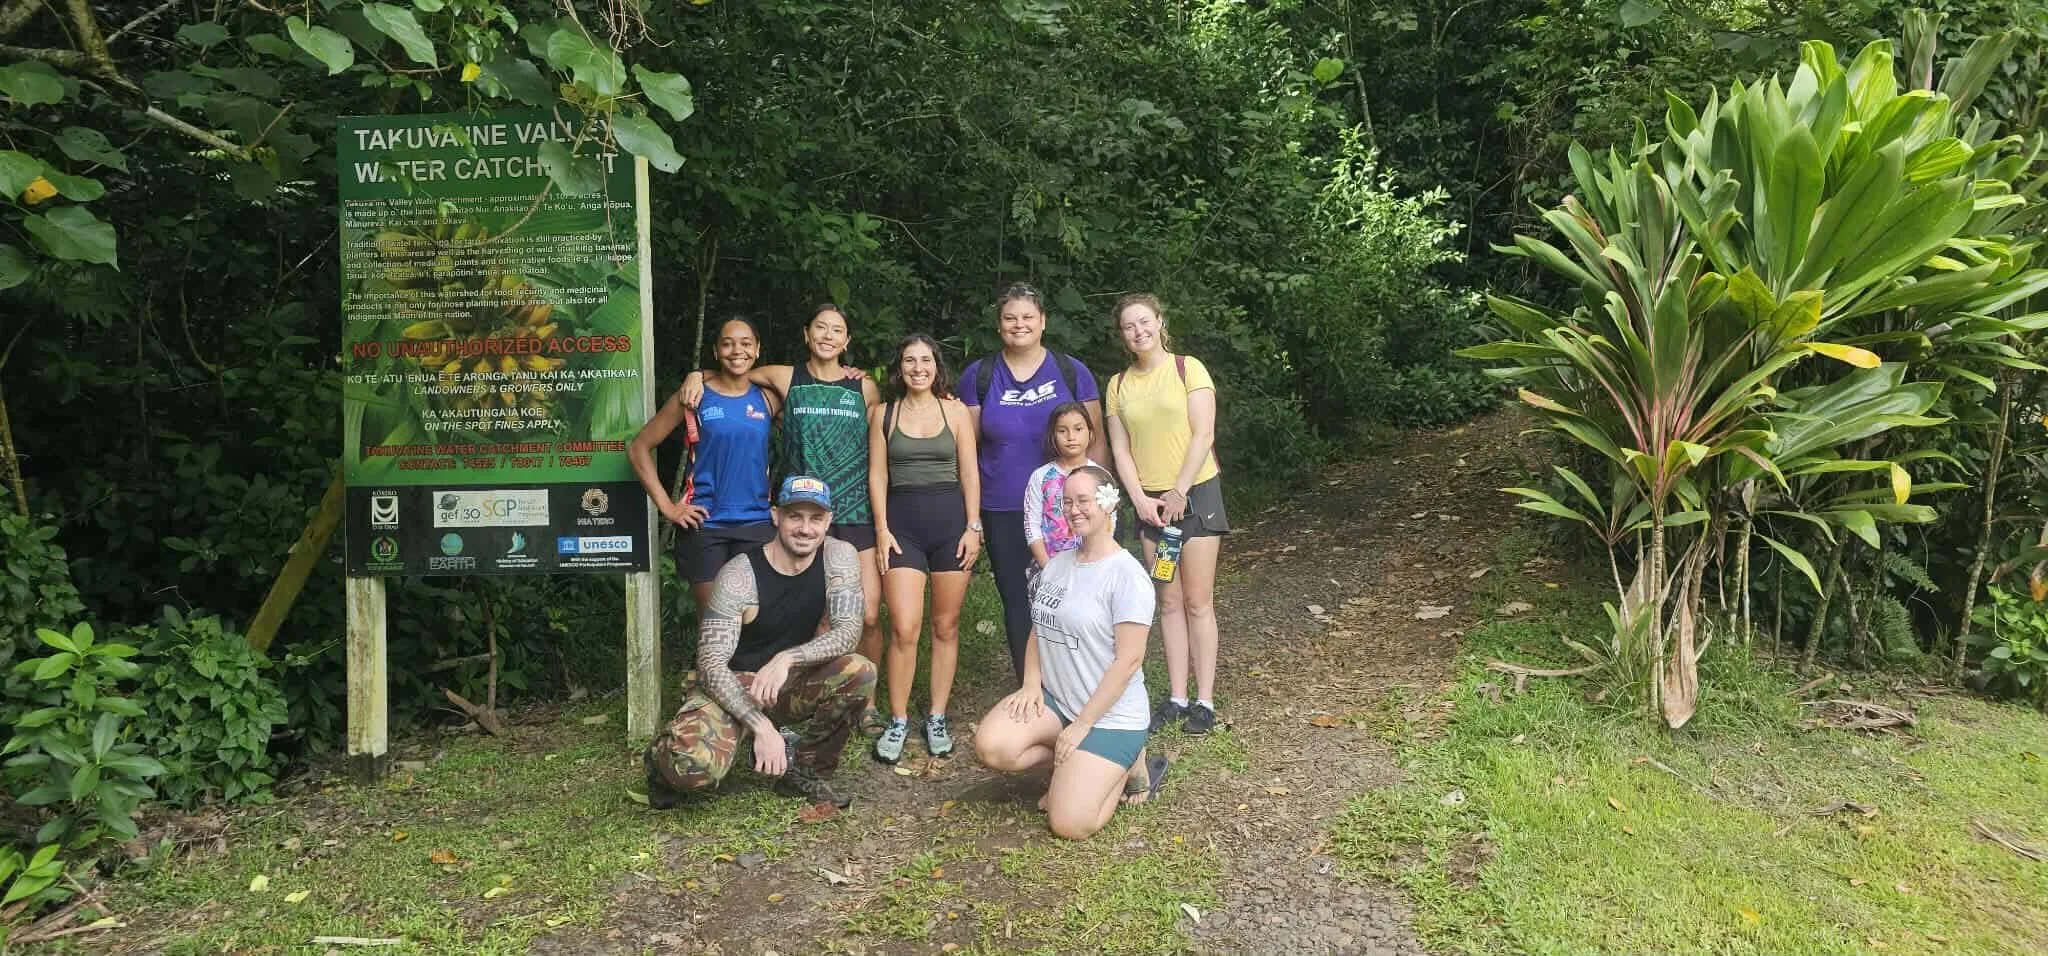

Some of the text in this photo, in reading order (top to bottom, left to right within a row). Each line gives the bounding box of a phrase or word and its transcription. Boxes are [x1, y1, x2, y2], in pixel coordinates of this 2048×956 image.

[455, 153, 619, 181] CATCHT
[354, 209, 374, 217] made
[378, 210, 389, 218] up
[537, 245, 552, 253] wild
[455, 257, 478, 267] plants
[548, 255, 570, 263] foods
[438, 288, 478, 297] watershed
[567, 285, 606, 293] medicinal
[347, 302, 382, 312] products
[409, 301, 426, 310] only
[466, 299, 498, 309] planting
[510, 298, 525, 306] this
[584, 296, 596, 304] for
[352, 335, 633, 359] NO UNAUTHORIZED ACCESS
[347, 375, 361, 384] KO
[364, 375, 377, 384] TE
[463, 372, 508, 382] ARONGA
[511, 371, 537, 380] TANU
[540, 370, 558, 380] KAI
[560, 370, 575, 379] KA
[414, 382, 584, 395] LANDOWNERS & GROWERS ONLY
[1001, 380, 1057, 402] EAS
[422, 410, 436, 418] KA
[520, 408, 543, 417] KOE
[424, 419, 561, 431] ON THE SPOT FINES APPLY
[436, 444, 476, 454] WATER
[480, 442, 552, 454] CATCHMENT
[556, 440, 625, 452] COMMITTEE
[440, 510, 459, 520] gef
[464, 508, 481, 520] 30
[482, 498, 518, 518] SGP
[583, 540, 628, 550] unesco
